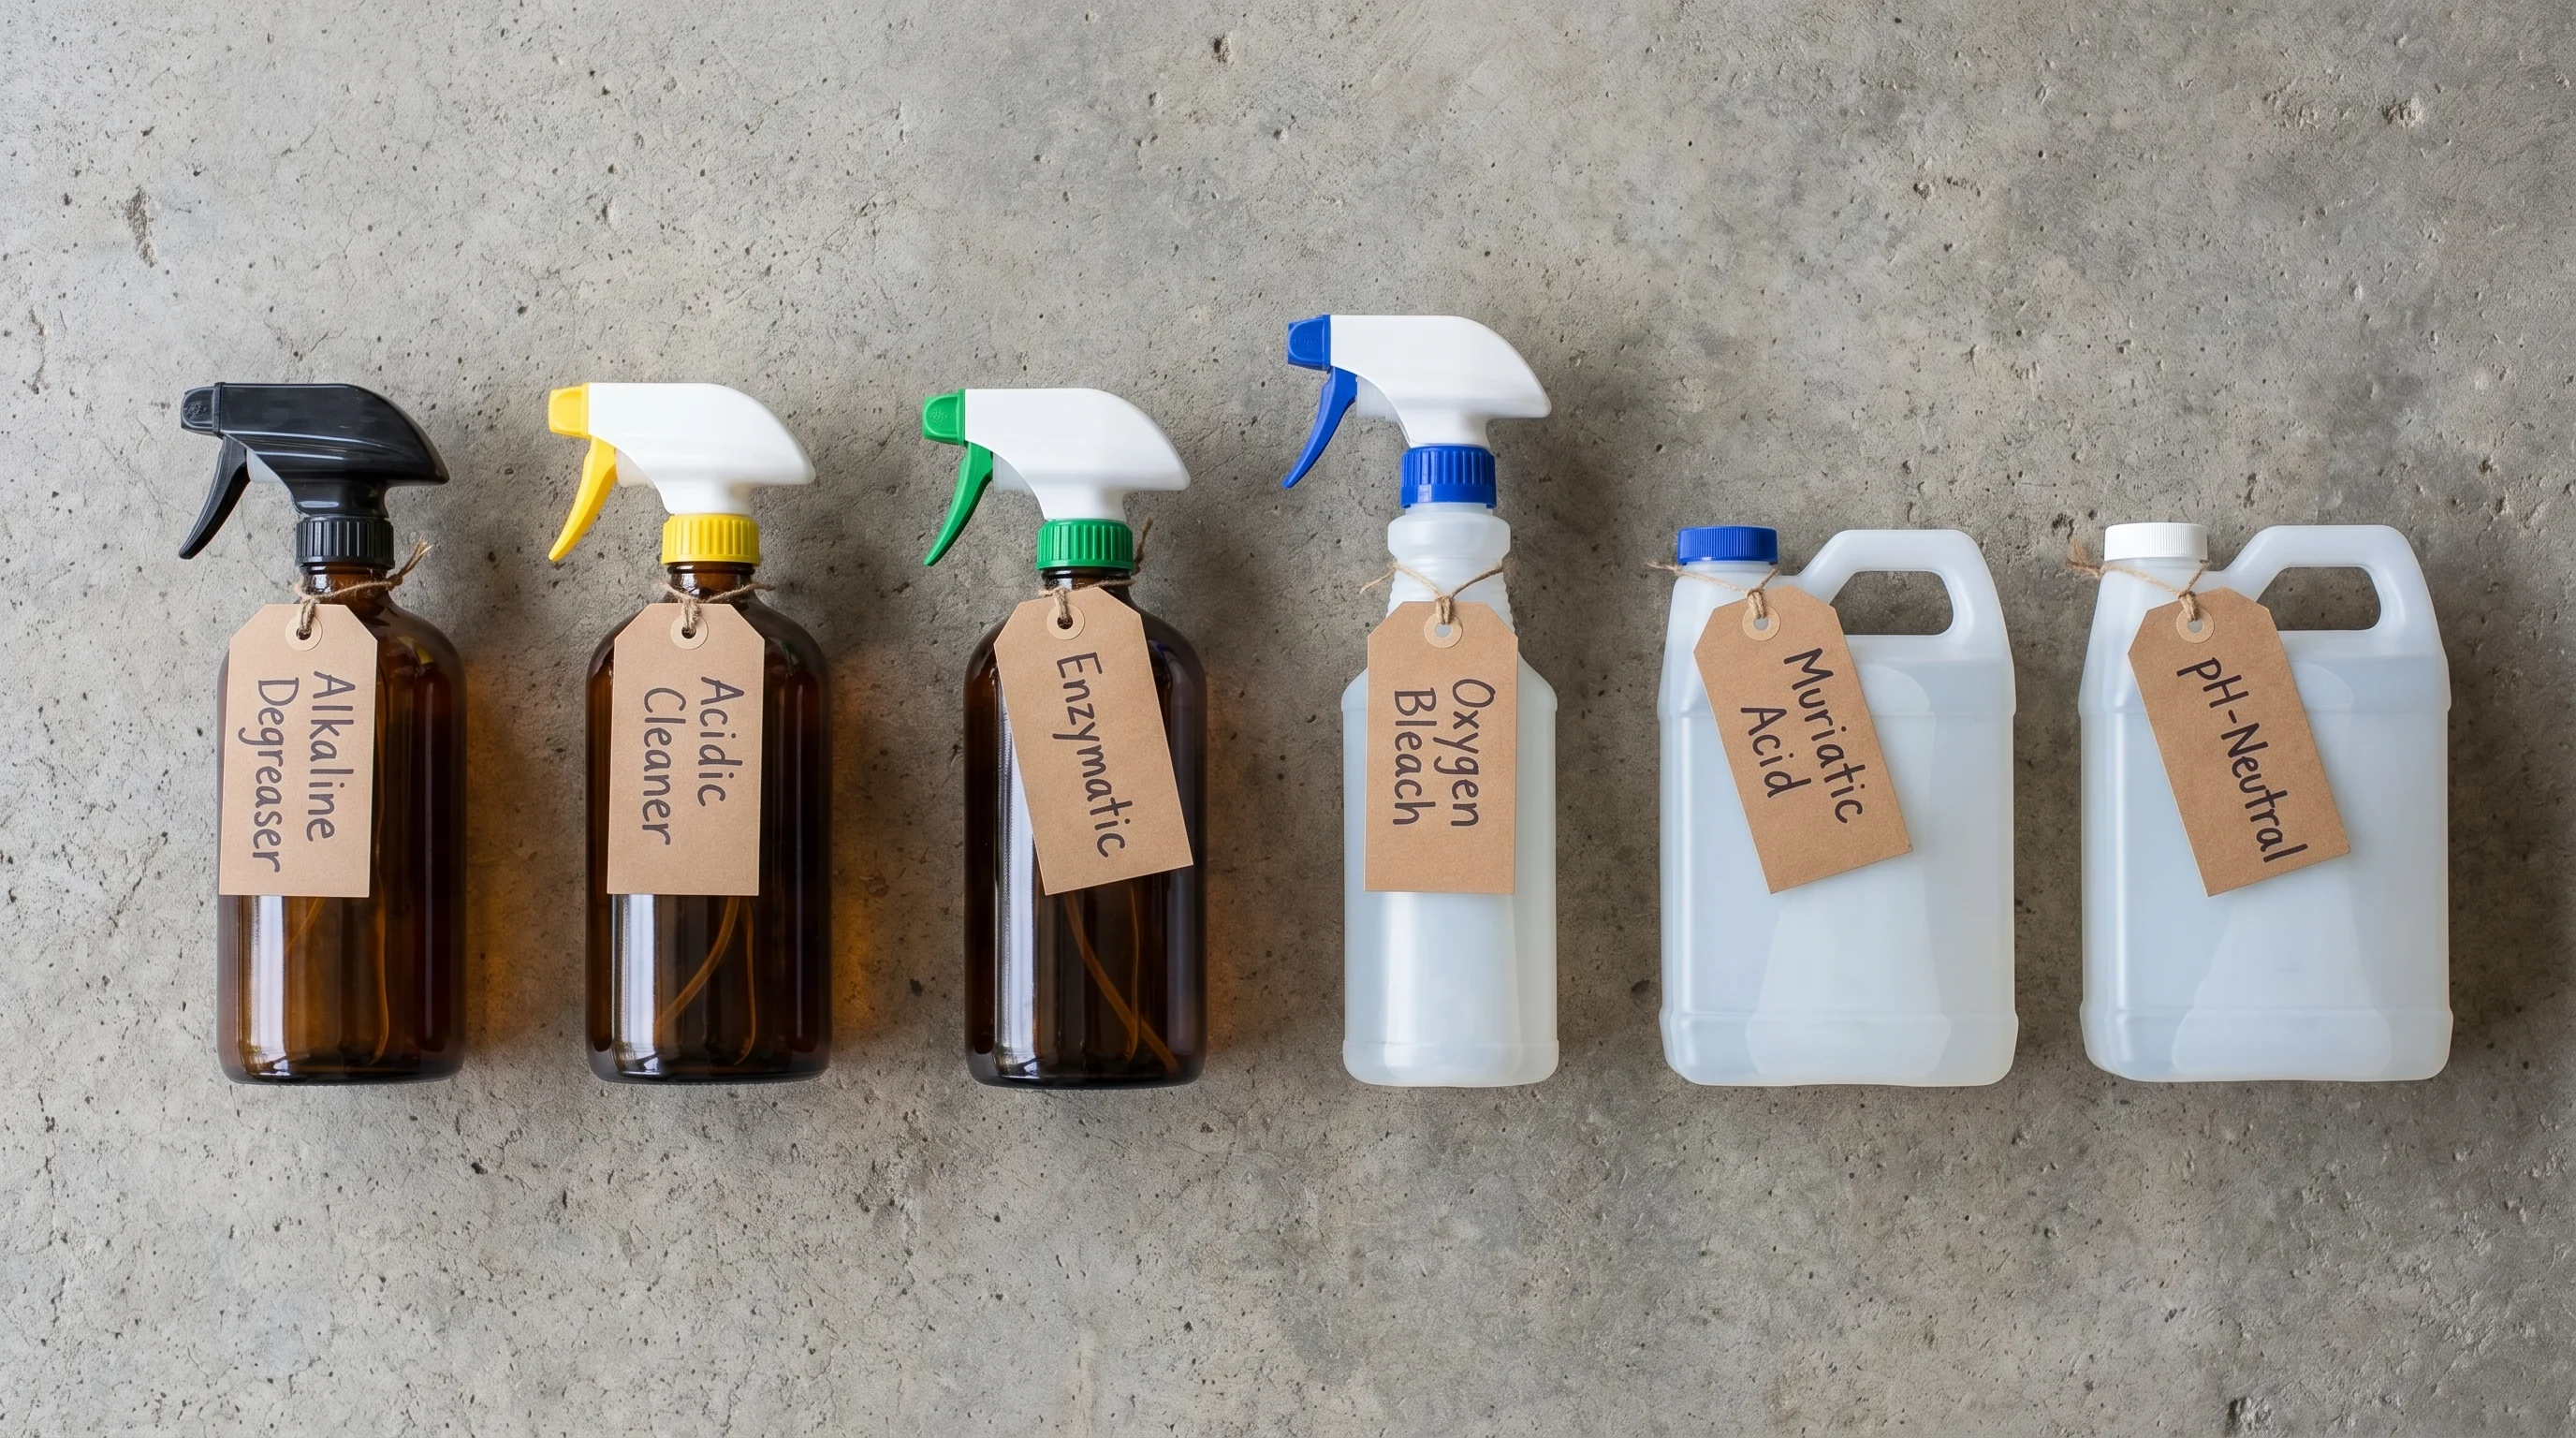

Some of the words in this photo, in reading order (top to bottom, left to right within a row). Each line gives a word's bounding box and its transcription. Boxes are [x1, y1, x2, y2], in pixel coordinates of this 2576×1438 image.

[238, 676, 300, 873] Degreaser
[305, 670, 357, 843] Alkaline
[641, 686, 688, 846] Cleaner
[696, 675, 746, 808] Acidic
[1051, 651, 1134, 859] Enzymatic
[1392, 686, 1438, 827] Bleach
[1432, 678, 1497, 828] Oxygen
[1740, 706, 1813, 800] Acid
[1782, 646, 1866, 825] Muriatic
[2175, 655, 2310, 864] pH-Neutral
